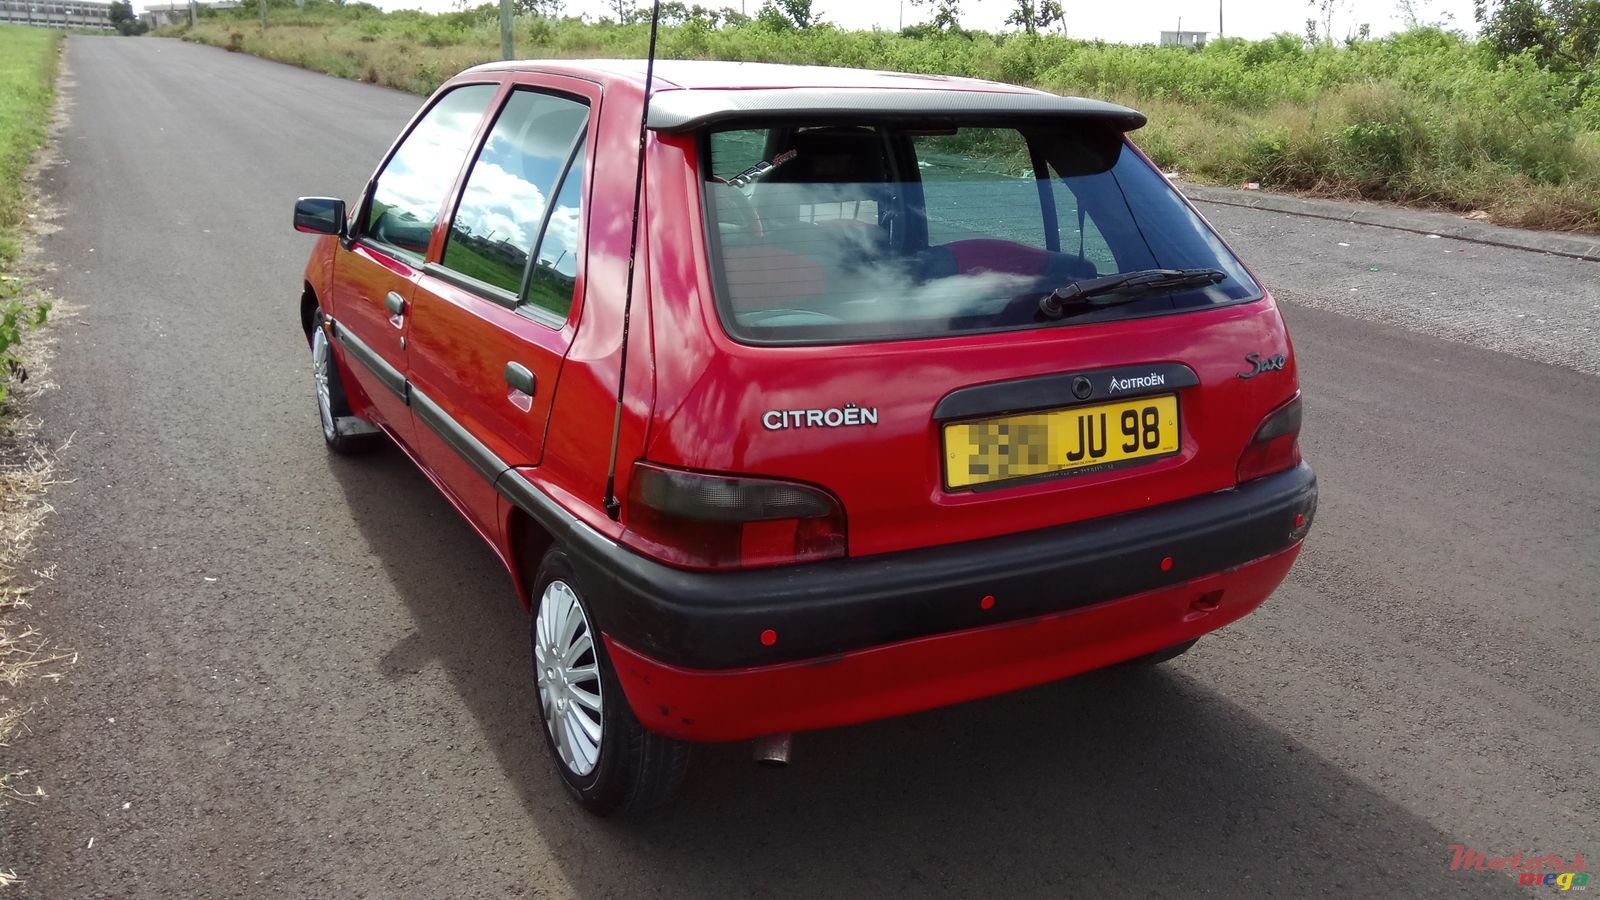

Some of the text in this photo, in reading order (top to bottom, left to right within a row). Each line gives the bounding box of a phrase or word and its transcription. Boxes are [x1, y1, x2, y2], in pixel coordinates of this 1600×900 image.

[1236, 352, 1285, 379] Saxo
[1120, 372, 1165, 390] CITROËN
[762, 403, 878, 430] CITROËN
[1066, 413, 1107, 462] JU
[1120, 406, 1161, 454] 98
